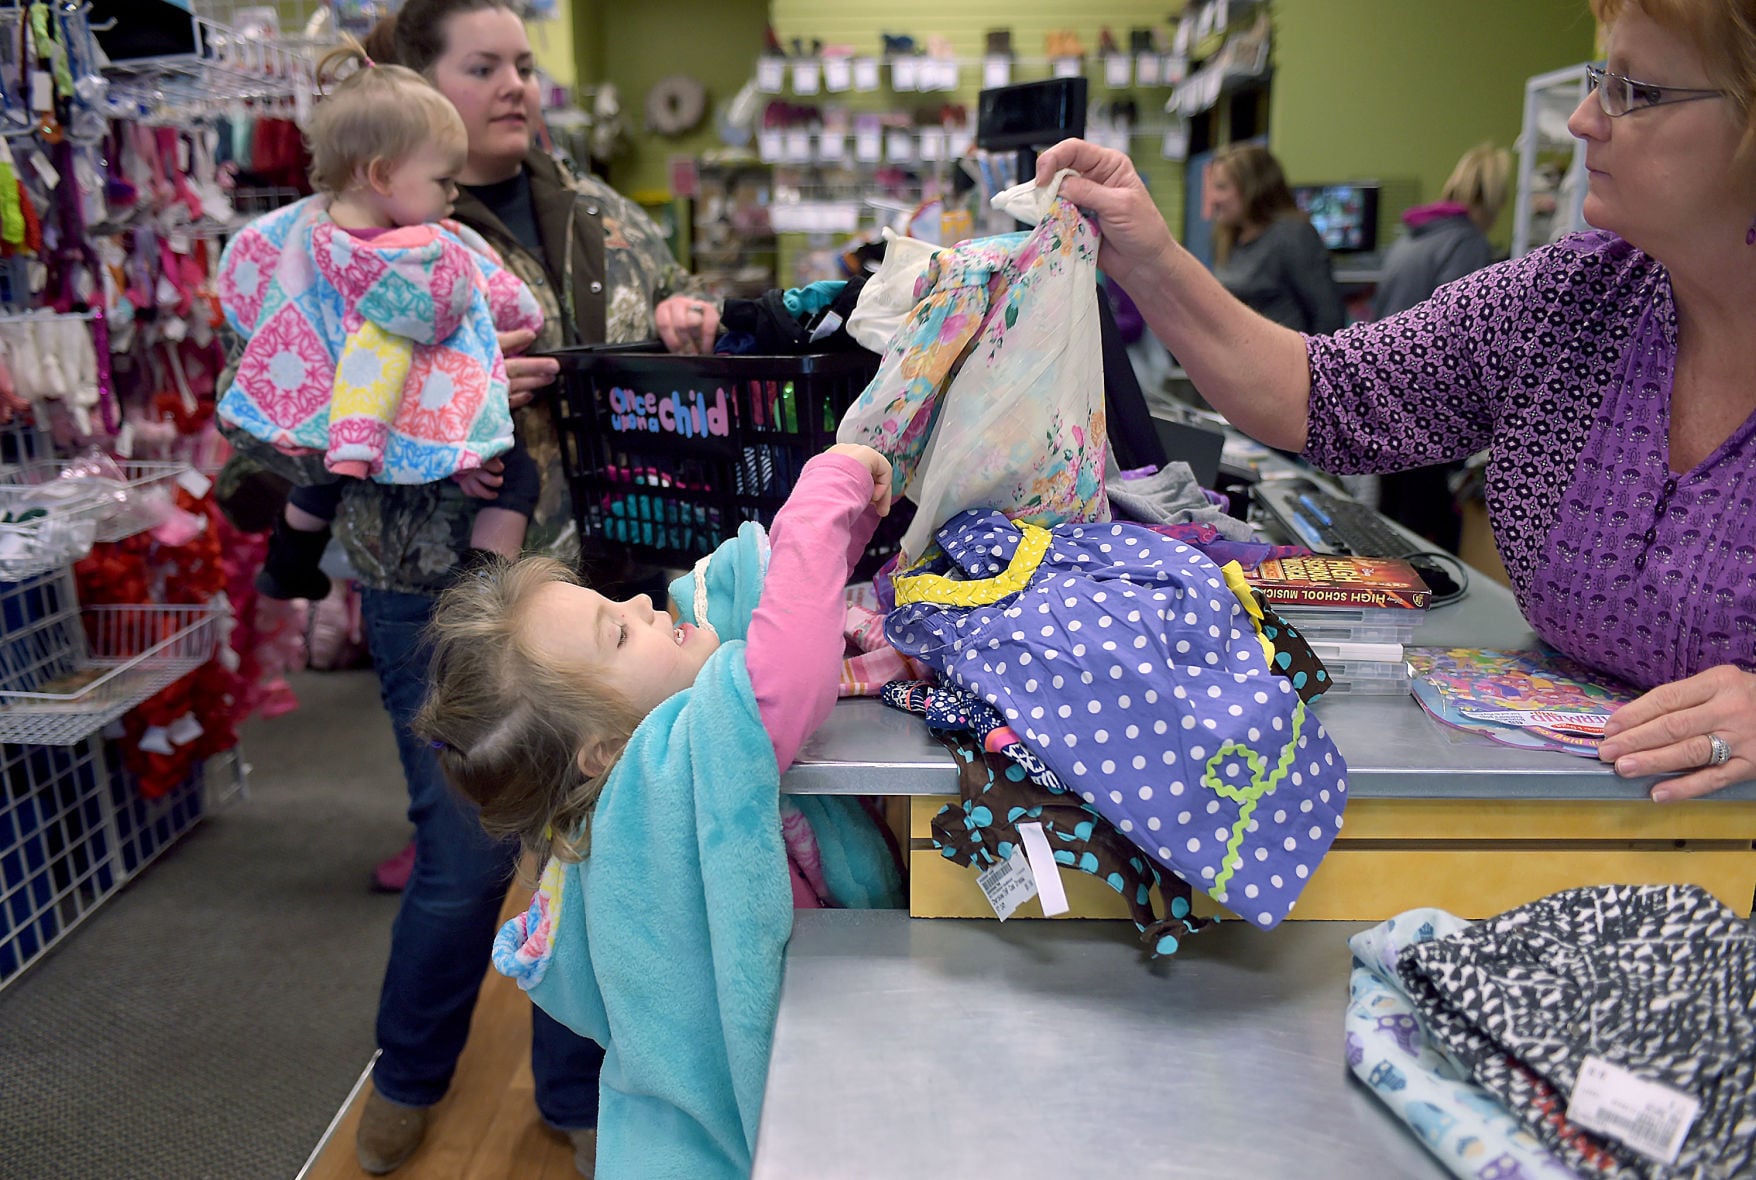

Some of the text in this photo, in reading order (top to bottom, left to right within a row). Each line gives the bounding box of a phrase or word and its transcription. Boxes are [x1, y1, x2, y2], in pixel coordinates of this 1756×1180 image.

[609, 386, 657, 415] Once
[611, 413, 660, 433] upon a
[1325, 560, 1363, 583] HIGH
[1301, 590, 1348, 601] SCHOOL
[1350, 592, 1386, 604] HIGH
